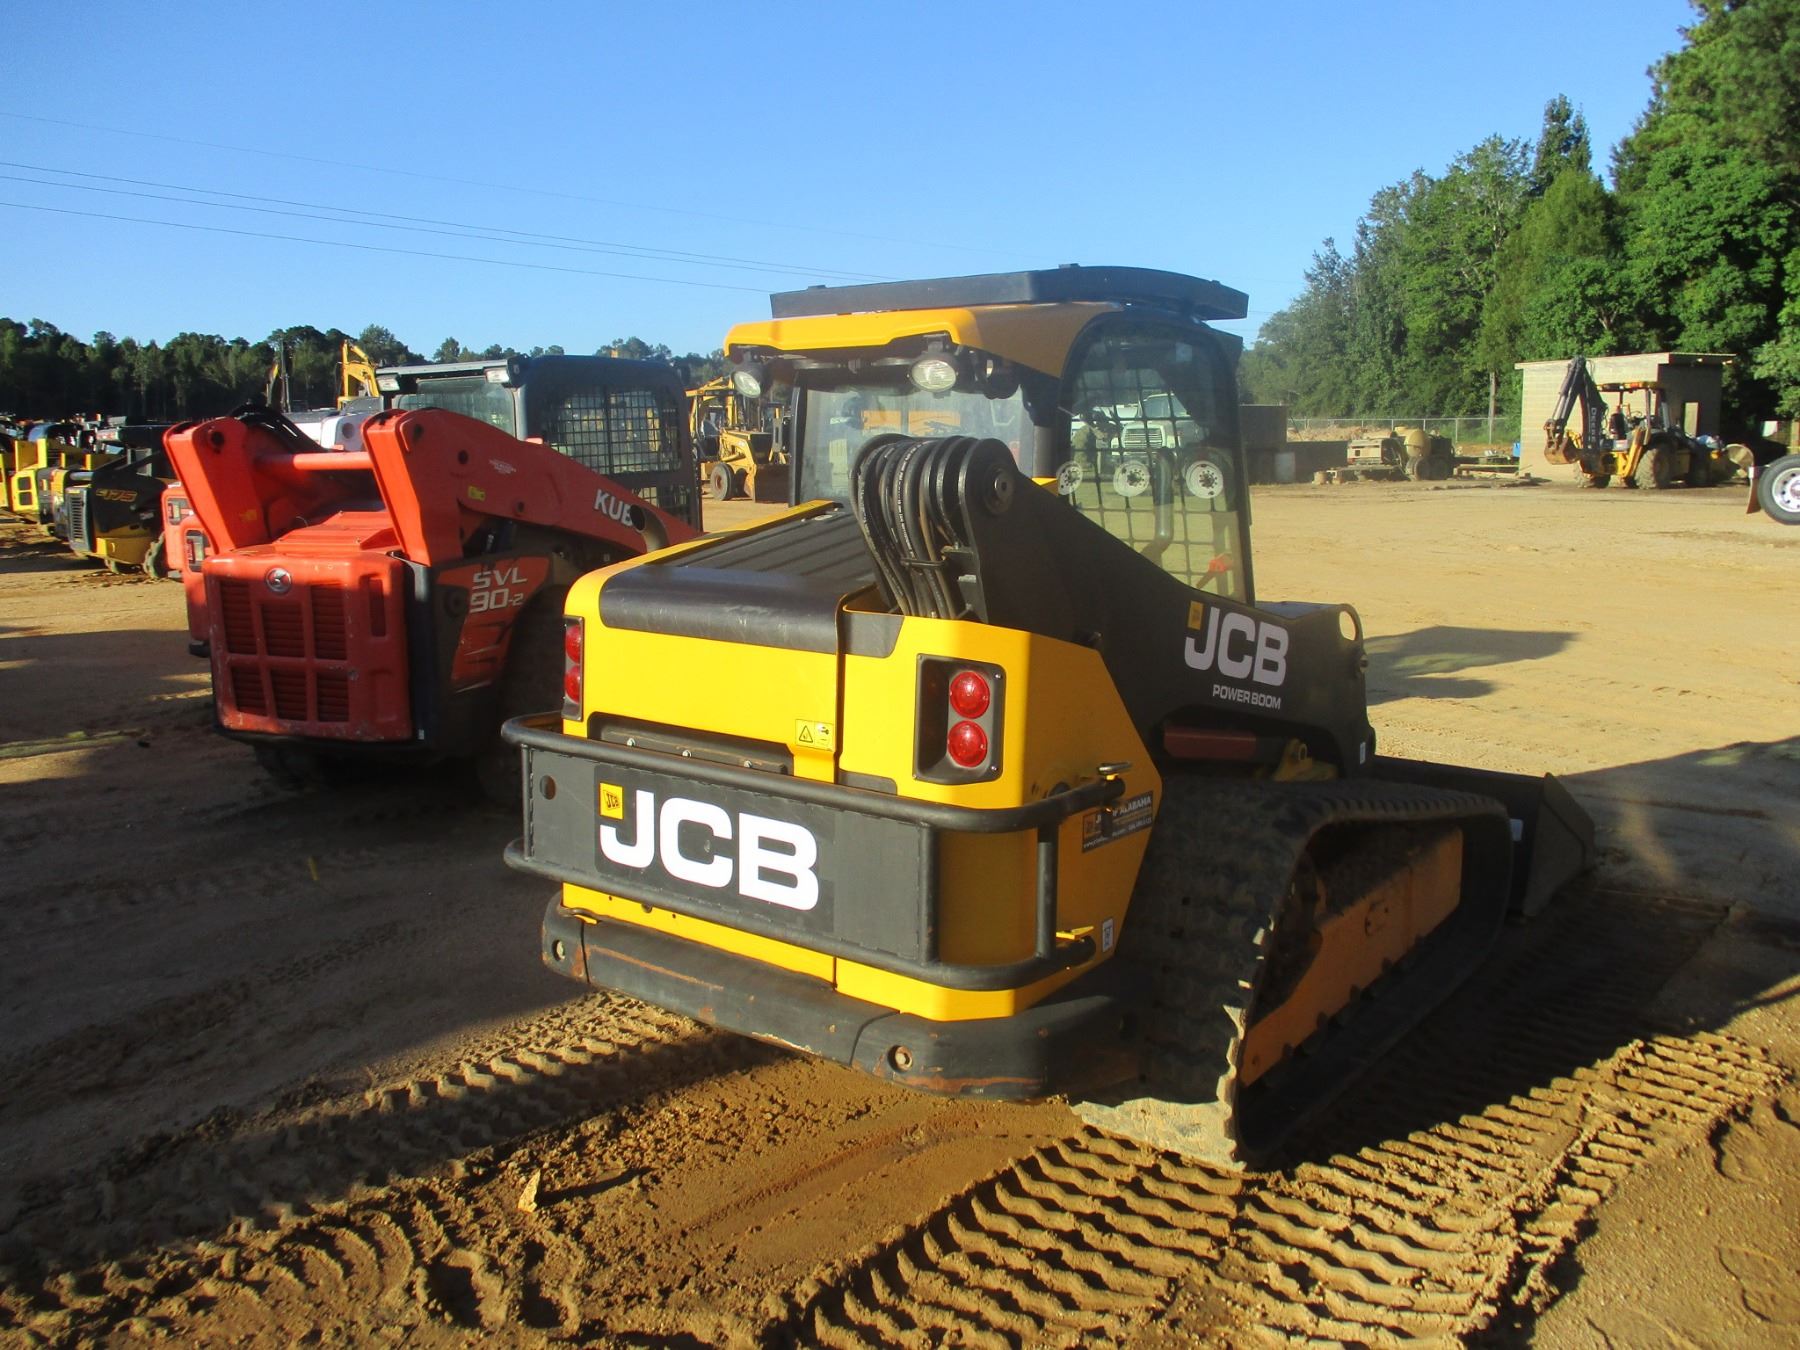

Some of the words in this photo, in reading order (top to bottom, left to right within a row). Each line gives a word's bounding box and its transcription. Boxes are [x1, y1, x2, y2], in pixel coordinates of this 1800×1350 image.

[469, 588, 524, 614] 90-2
[472, 567, 528, 590] SVL
[1184, 606, 1289, 686] JCB
[600, 789, 819, 911] JCB
